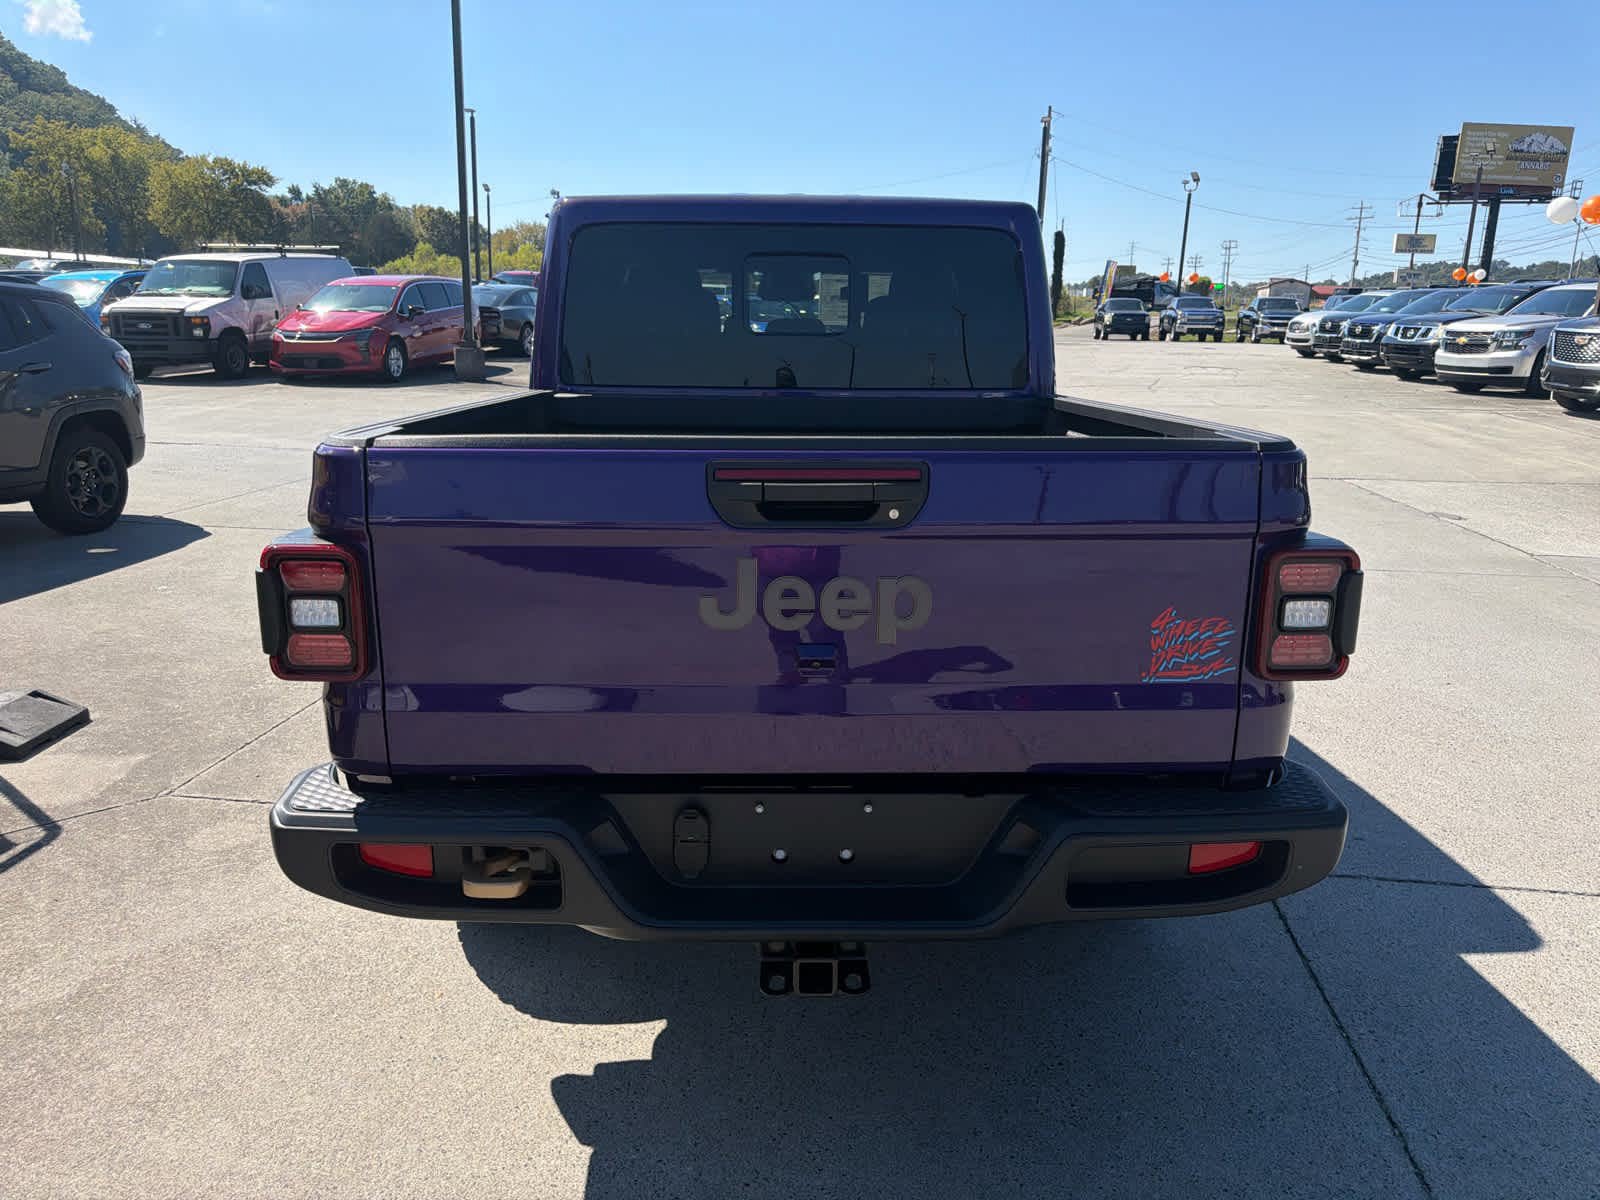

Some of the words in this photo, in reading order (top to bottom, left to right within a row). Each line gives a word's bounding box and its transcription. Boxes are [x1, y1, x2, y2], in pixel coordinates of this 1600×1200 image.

[699, 558, 933, 645] Jeep
[1151, 607, 1180, 631] 4
[1150, 638, 1231, 676] DRIVE
